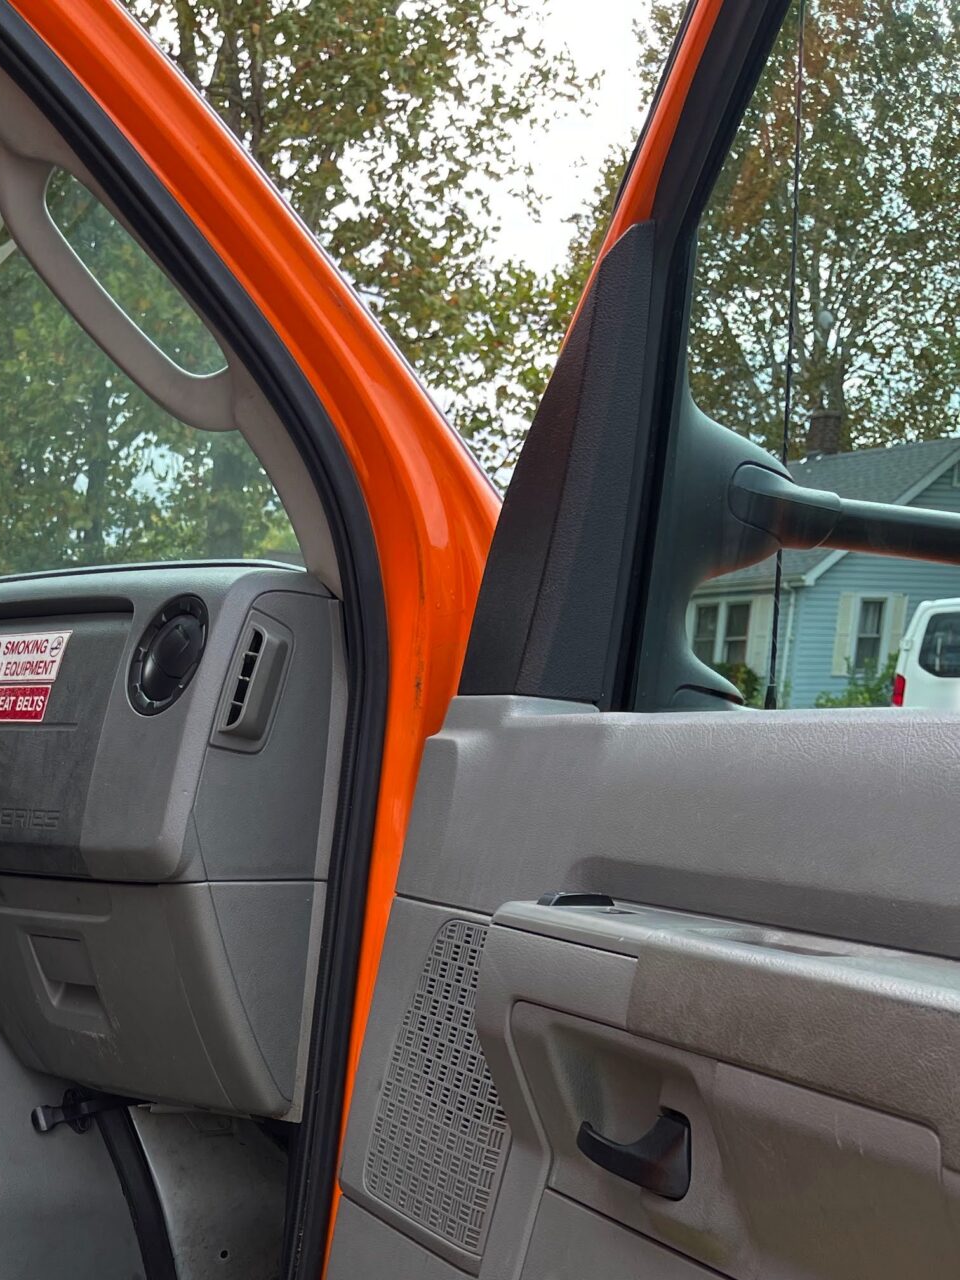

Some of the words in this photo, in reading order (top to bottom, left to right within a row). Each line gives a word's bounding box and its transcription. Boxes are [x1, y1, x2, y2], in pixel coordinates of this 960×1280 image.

[3, 639, 48, 656] SMOKING
[4, 660, 56, 676] EQUIPMENT
[16, 696, 45, 711] BELTS
